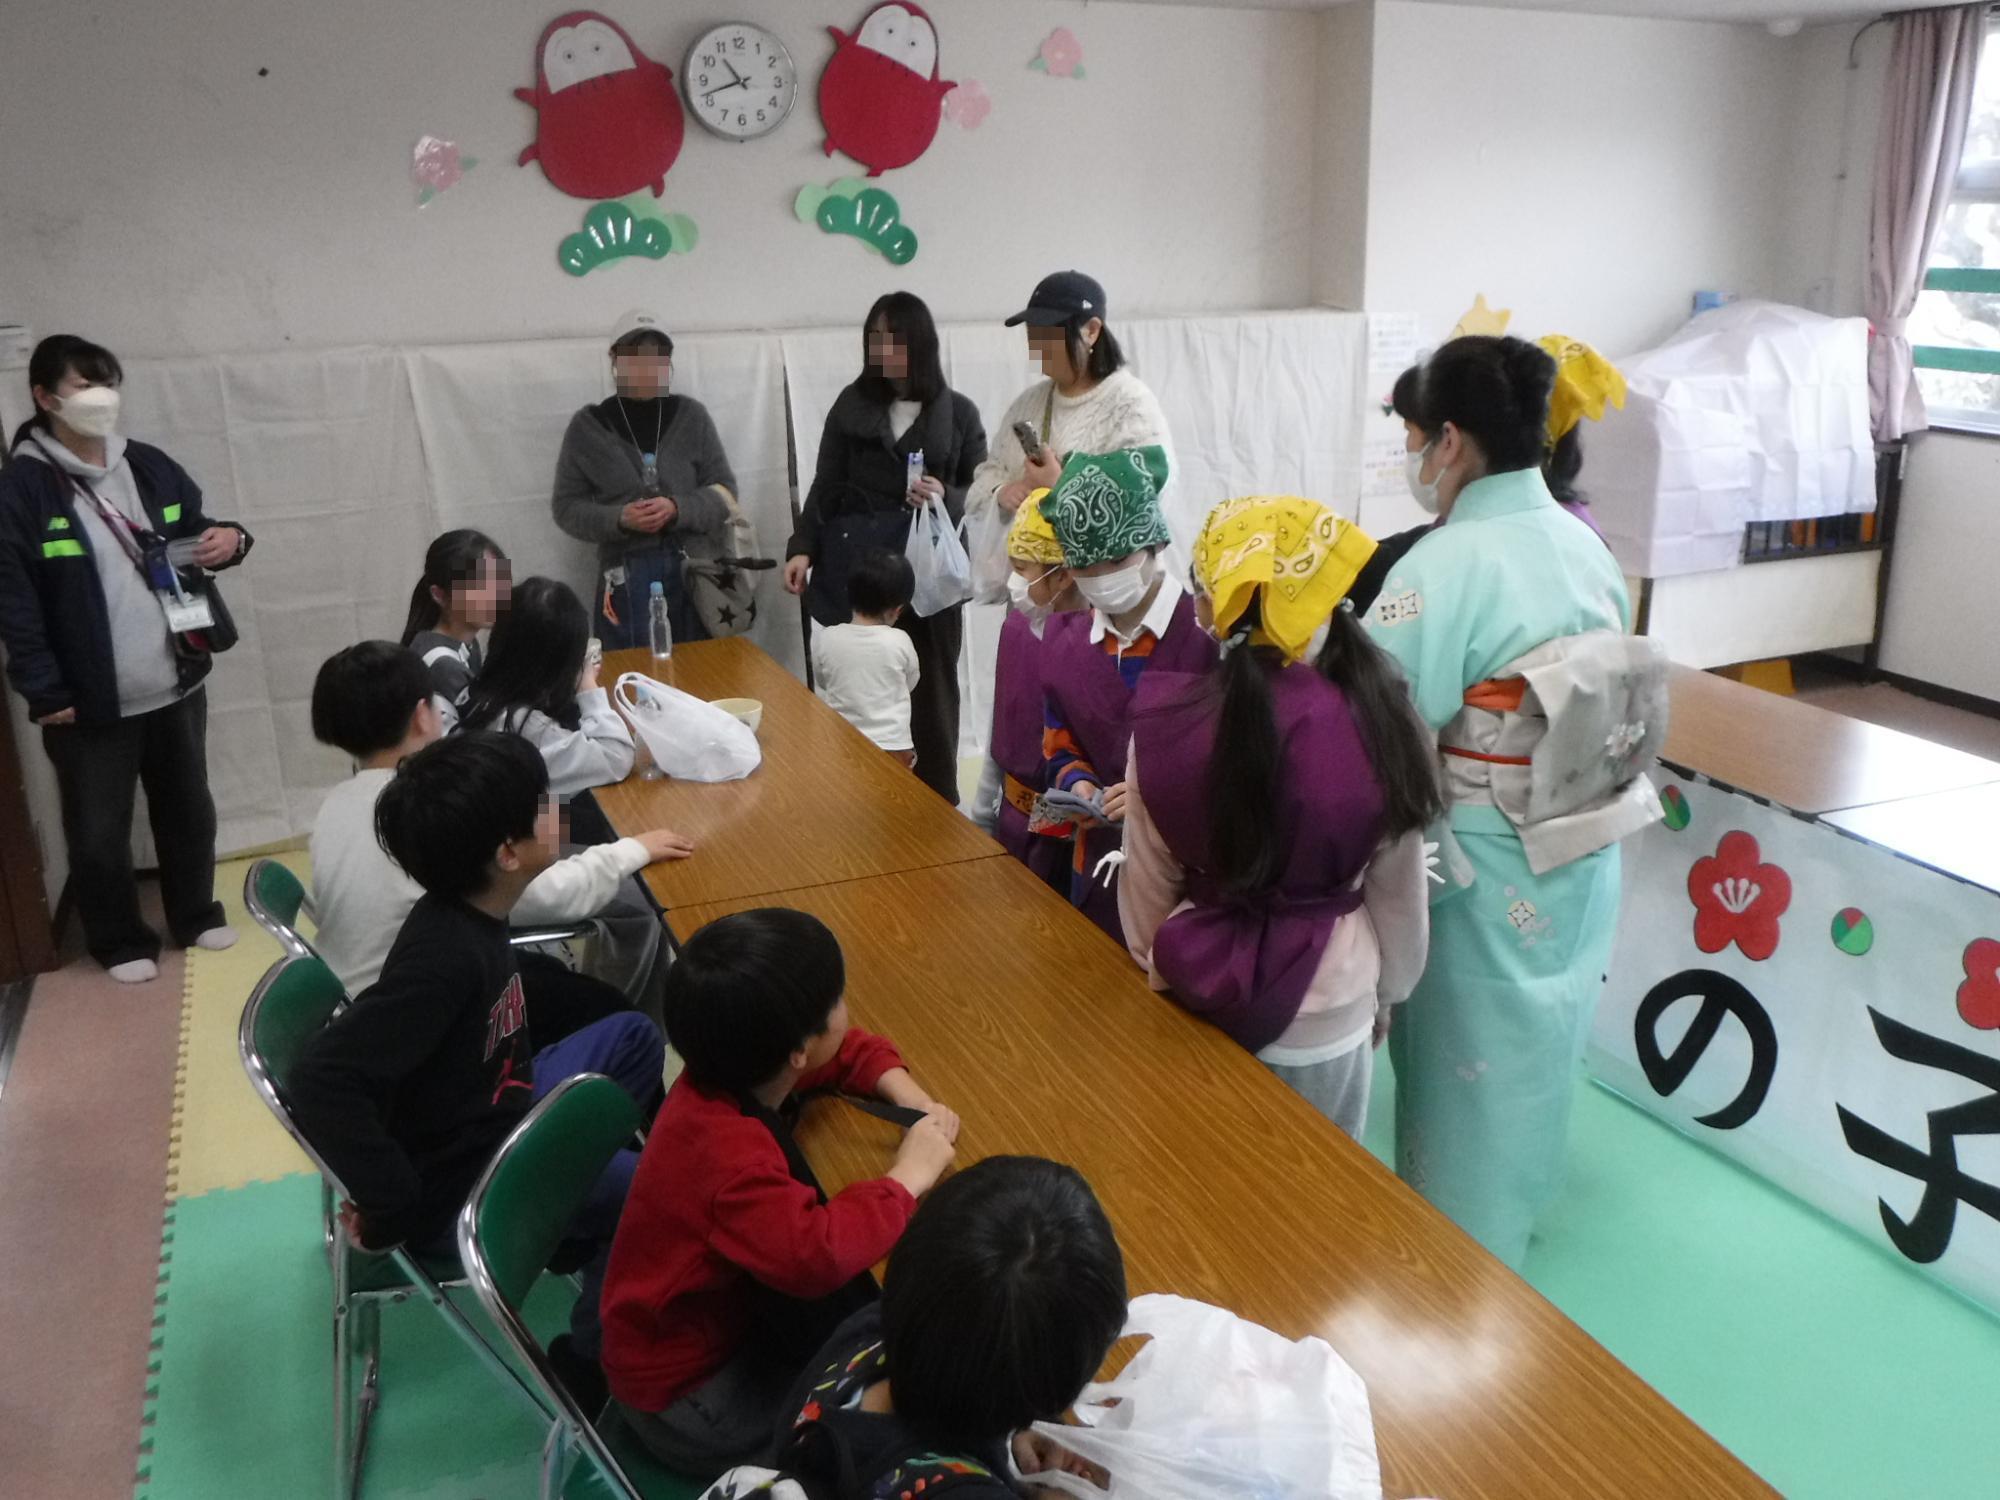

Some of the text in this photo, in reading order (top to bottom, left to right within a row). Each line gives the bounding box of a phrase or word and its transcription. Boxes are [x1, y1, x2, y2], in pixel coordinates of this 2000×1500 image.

[716, 41, 726, 53] 11
[733, 36, 745, 49] 12
[755, 42, 761, 54] 1
[702, 55, 716, 68] 10
[768, 56, 777, 68] 2
[699, 74, 708, 86] 9
[774, 76, 782, 88] 3
[706, 94, 715, 107] 8
[768, 96, 777, 108] 4
[721, 109, 729, 121] 7
[738, 114, 747, 126] 6
[757, 109, 766, 121] 5
